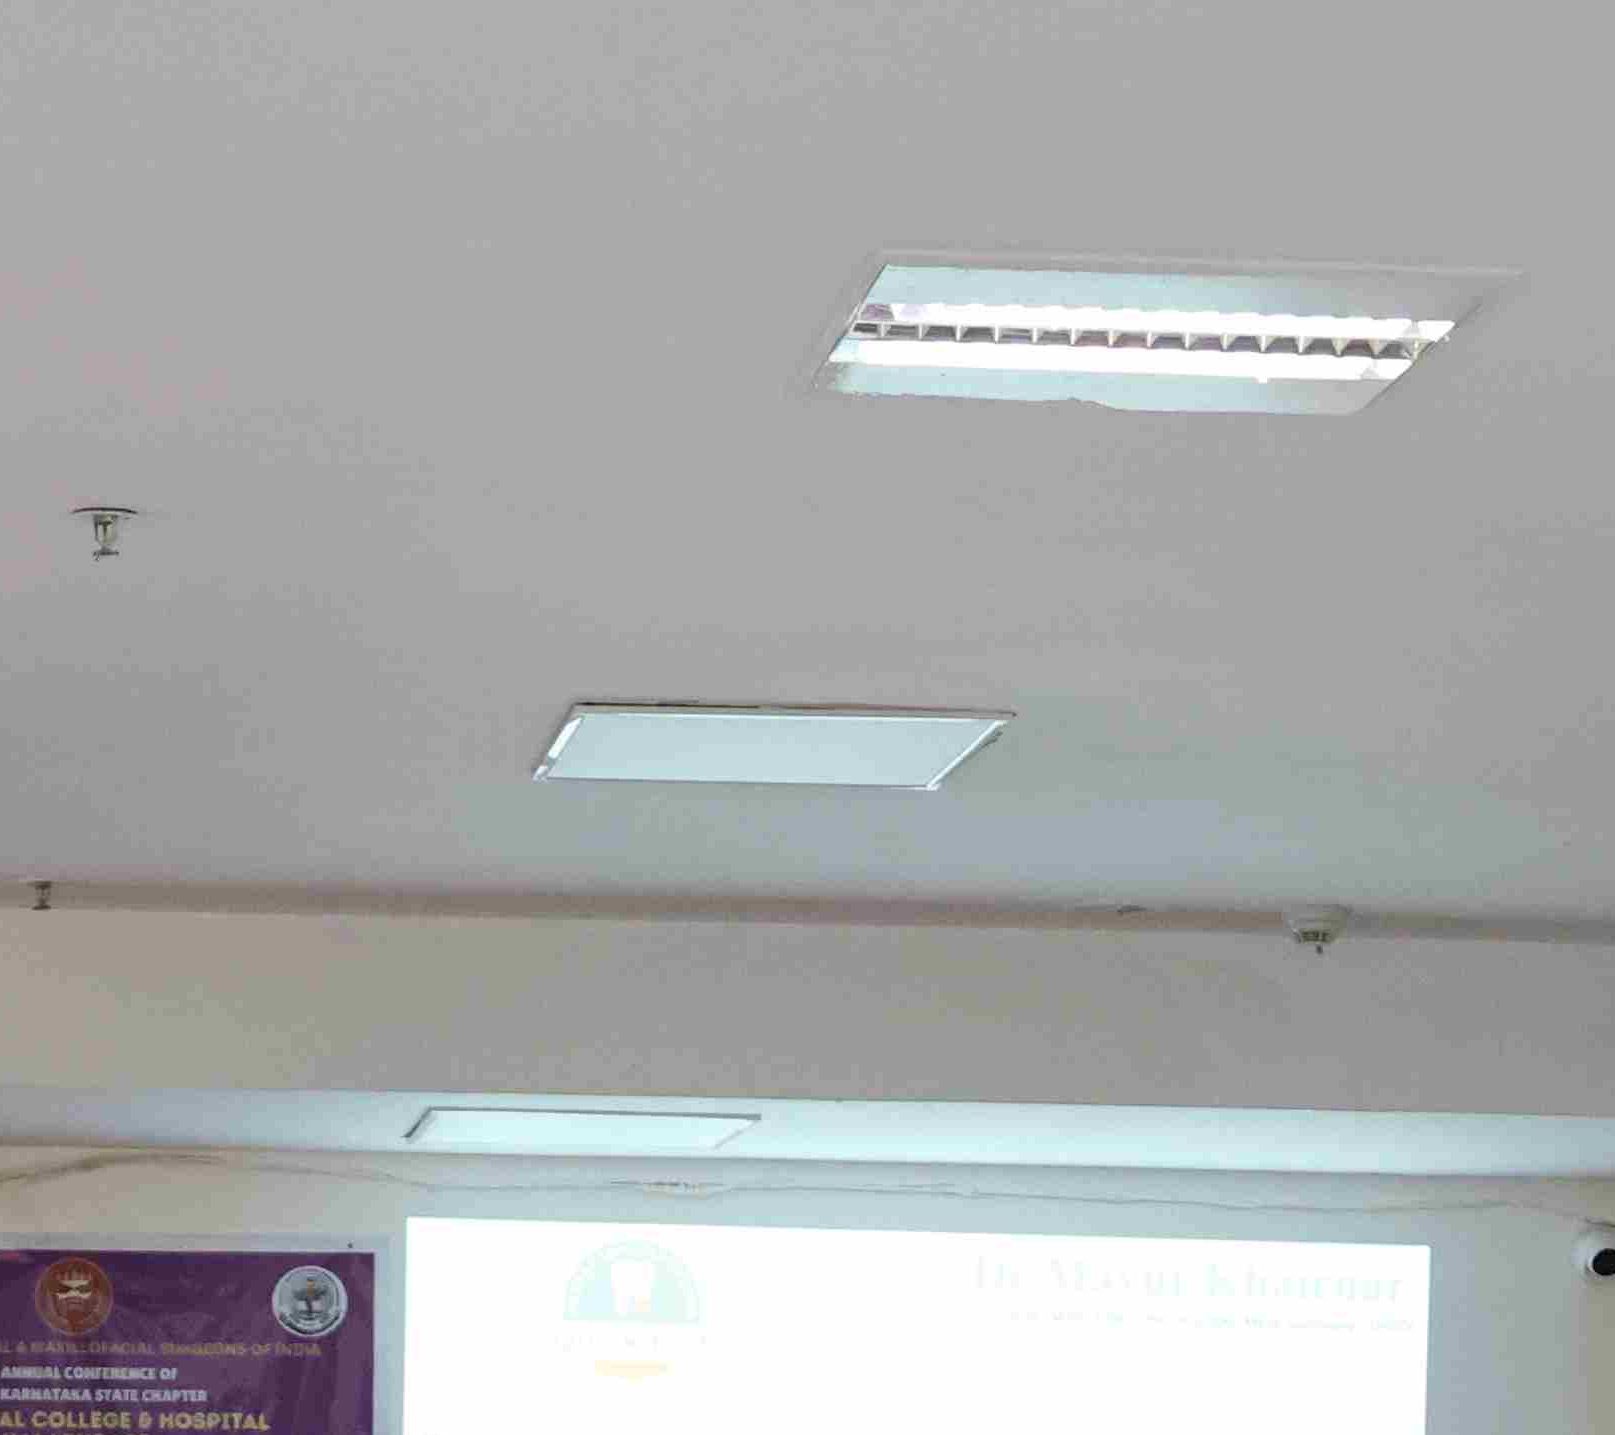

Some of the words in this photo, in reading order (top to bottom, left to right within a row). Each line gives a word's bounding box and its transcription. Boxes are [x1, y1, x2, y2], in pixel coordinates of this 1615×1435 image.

[1, 1366, 61, 1380] ANNUAL
[64, 1366, 157, 1380] CONFERENCE
[159, 1366, 178, 1380] OF
[0, 1387, 93, 1402] KARNATAKA
[95, 1388, 139, 1403] STATE
[142, 1389, 209, 1403] CHAPTER
[32, 1411, 134, 1430] COLLEGE
[158, 1411, 270, 1432] HOSPITAL
